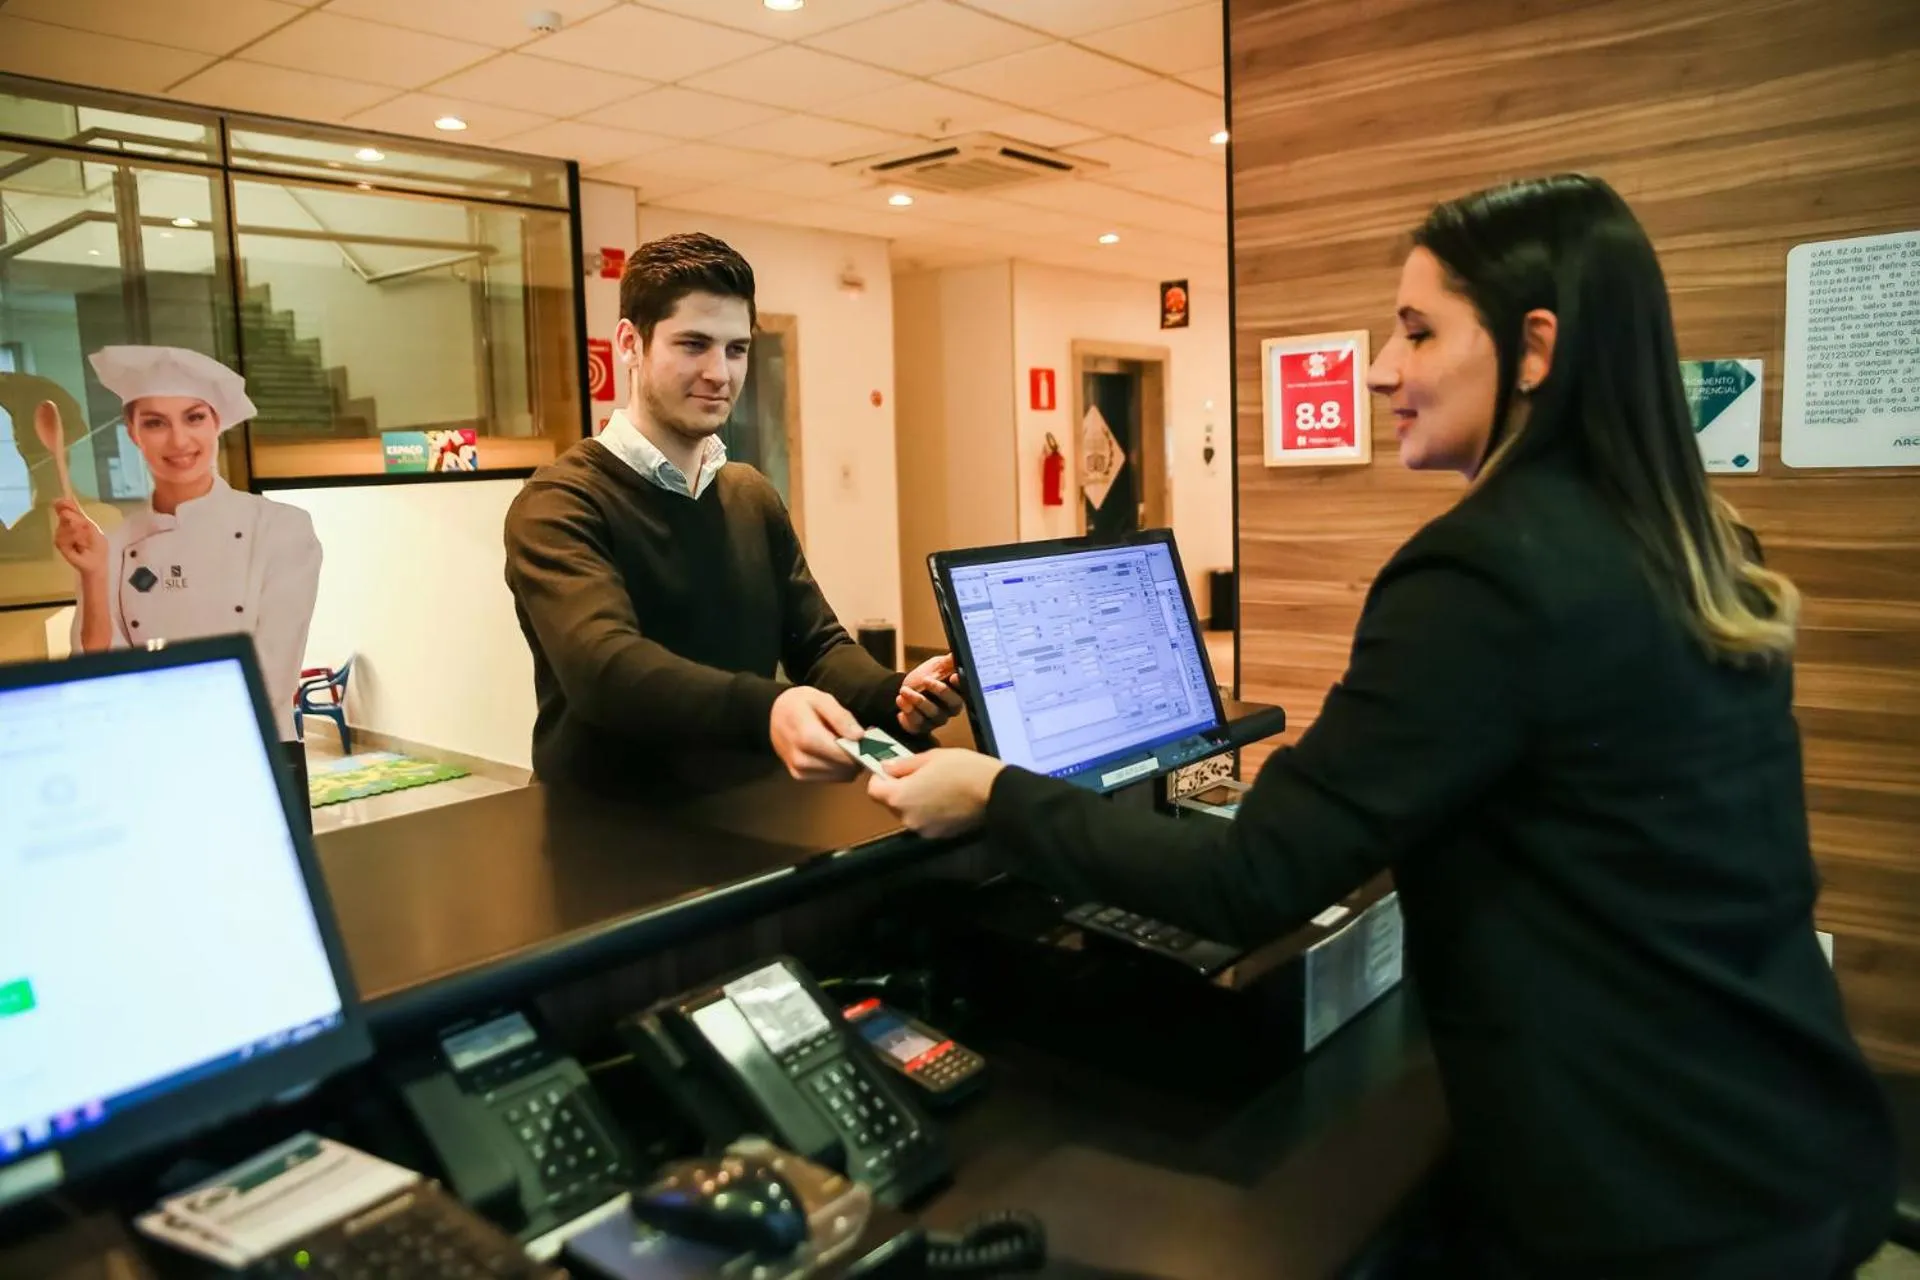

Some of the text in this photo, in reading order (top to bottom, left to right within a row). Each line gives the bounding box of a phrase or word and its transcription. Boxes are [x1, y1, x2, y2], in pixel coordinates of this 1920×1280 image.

[1810, 257, 1863, 268] adolescente
[1809, 269, 1831, 278] julho
[1879, 261, 1907, 271] define
[1809, 274, 1880, 286] hospedagem
[1889, 271, 1902, 279] de
[1809, 284, 1872, 296] adolescente
[1880, 282, 1895, 290] em
[1863, 301, 1887, 310] salvo
[1808, 312, 1870, 324] acompanhado
[1873, 310, 1898, 319] pelos
[1840, 322, 1853, 331] Se
[1863, 320, 1894, 329] senhor
[1876, 328, 1904, 337] sendo
[1849, 339, 1889, 350] discando
[1855, 358, 1892, 368] crianças
[1858, 367, 1899, 377] denuncie
[1824, 387, 1883, 398] paternidade
[1891, 386, 1903, 394] da
[1806, 398, 1860, 407] adolescente
[1295, 400, 1341, 431] 8.8
[1805, 407, 1866, 416] apresentação
